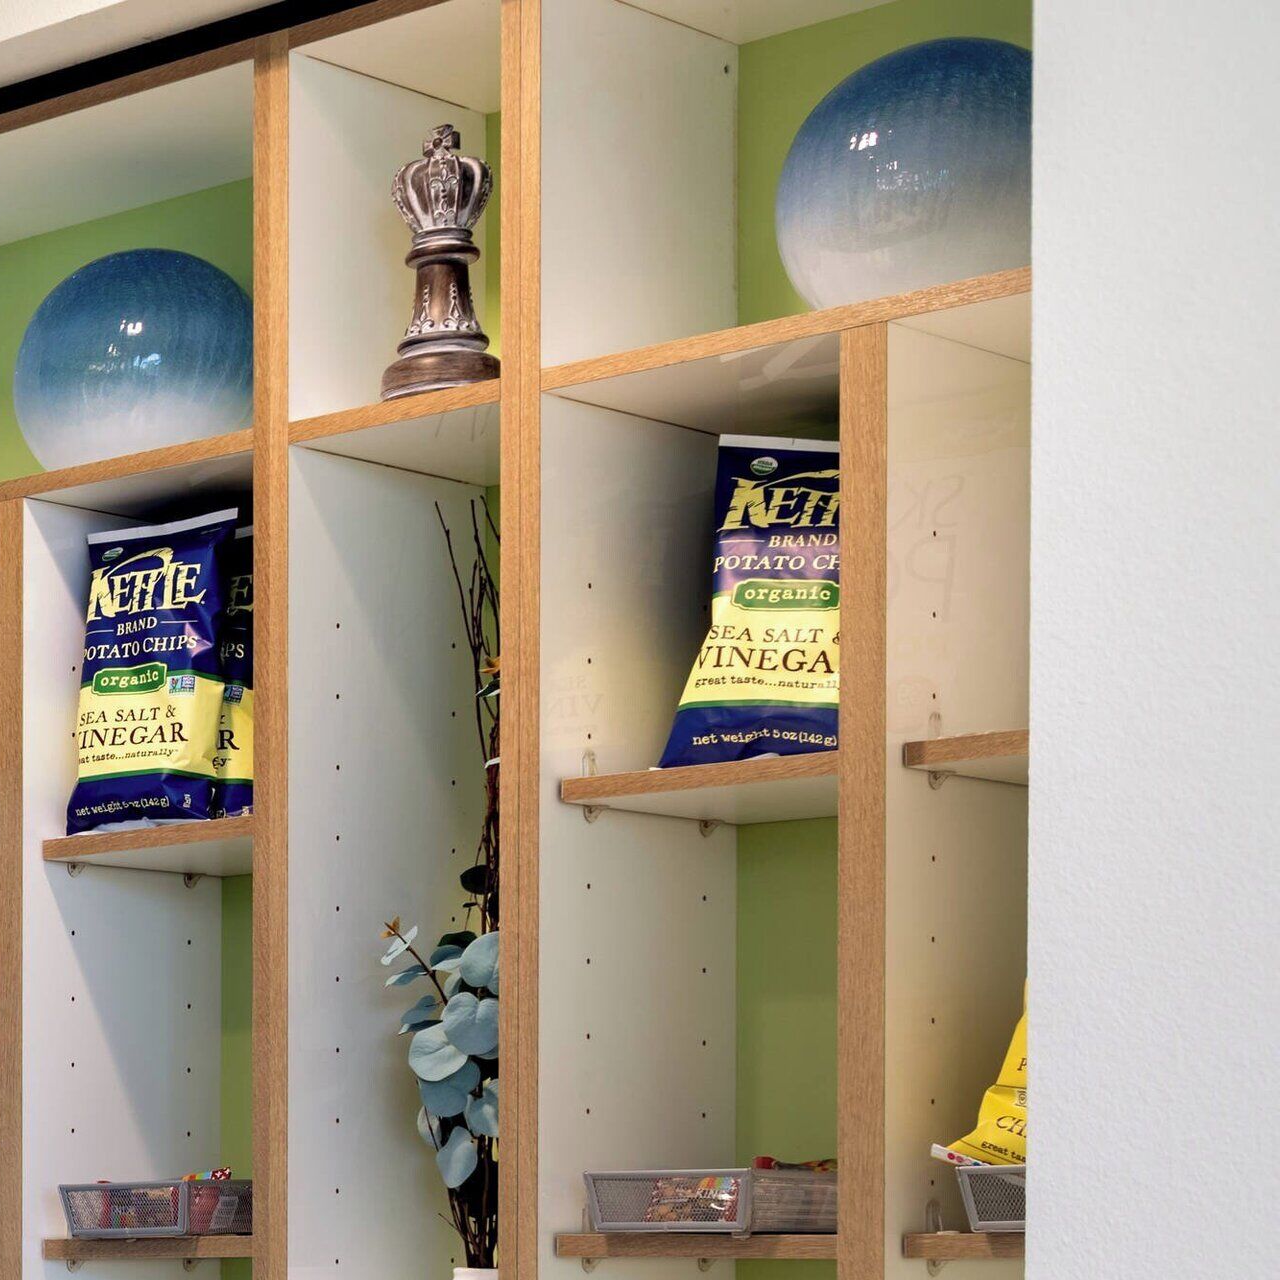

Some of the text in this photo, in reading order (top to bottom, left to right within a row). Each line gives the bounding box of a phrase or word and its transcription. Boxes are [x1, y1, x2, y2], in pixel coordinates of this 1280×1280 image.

[768, 533, 838, 548] BRAND
[712, 554, 806, 574] POTATO
[86, 547, 207, 624] KETTLE
[744, 587, 831, 603] organic
[116, 616, 158, 636] BRAND
[709, 625, 824, 644] SEA SALT
[142, 634, 198, 653] CHIPS
[697, 645, 839, 674] VINEGA
[100, 670, 159, 688] organic
[694, 675, 728, 689] great
[79, 704, 176, 727] SEA SALT &
[79, 722, 189, 750] INEGAR
[692, 728, 799, 746] net weight 5 oz
[75, 805, 90, 817] net
[91, 799, 123, 815] weight
